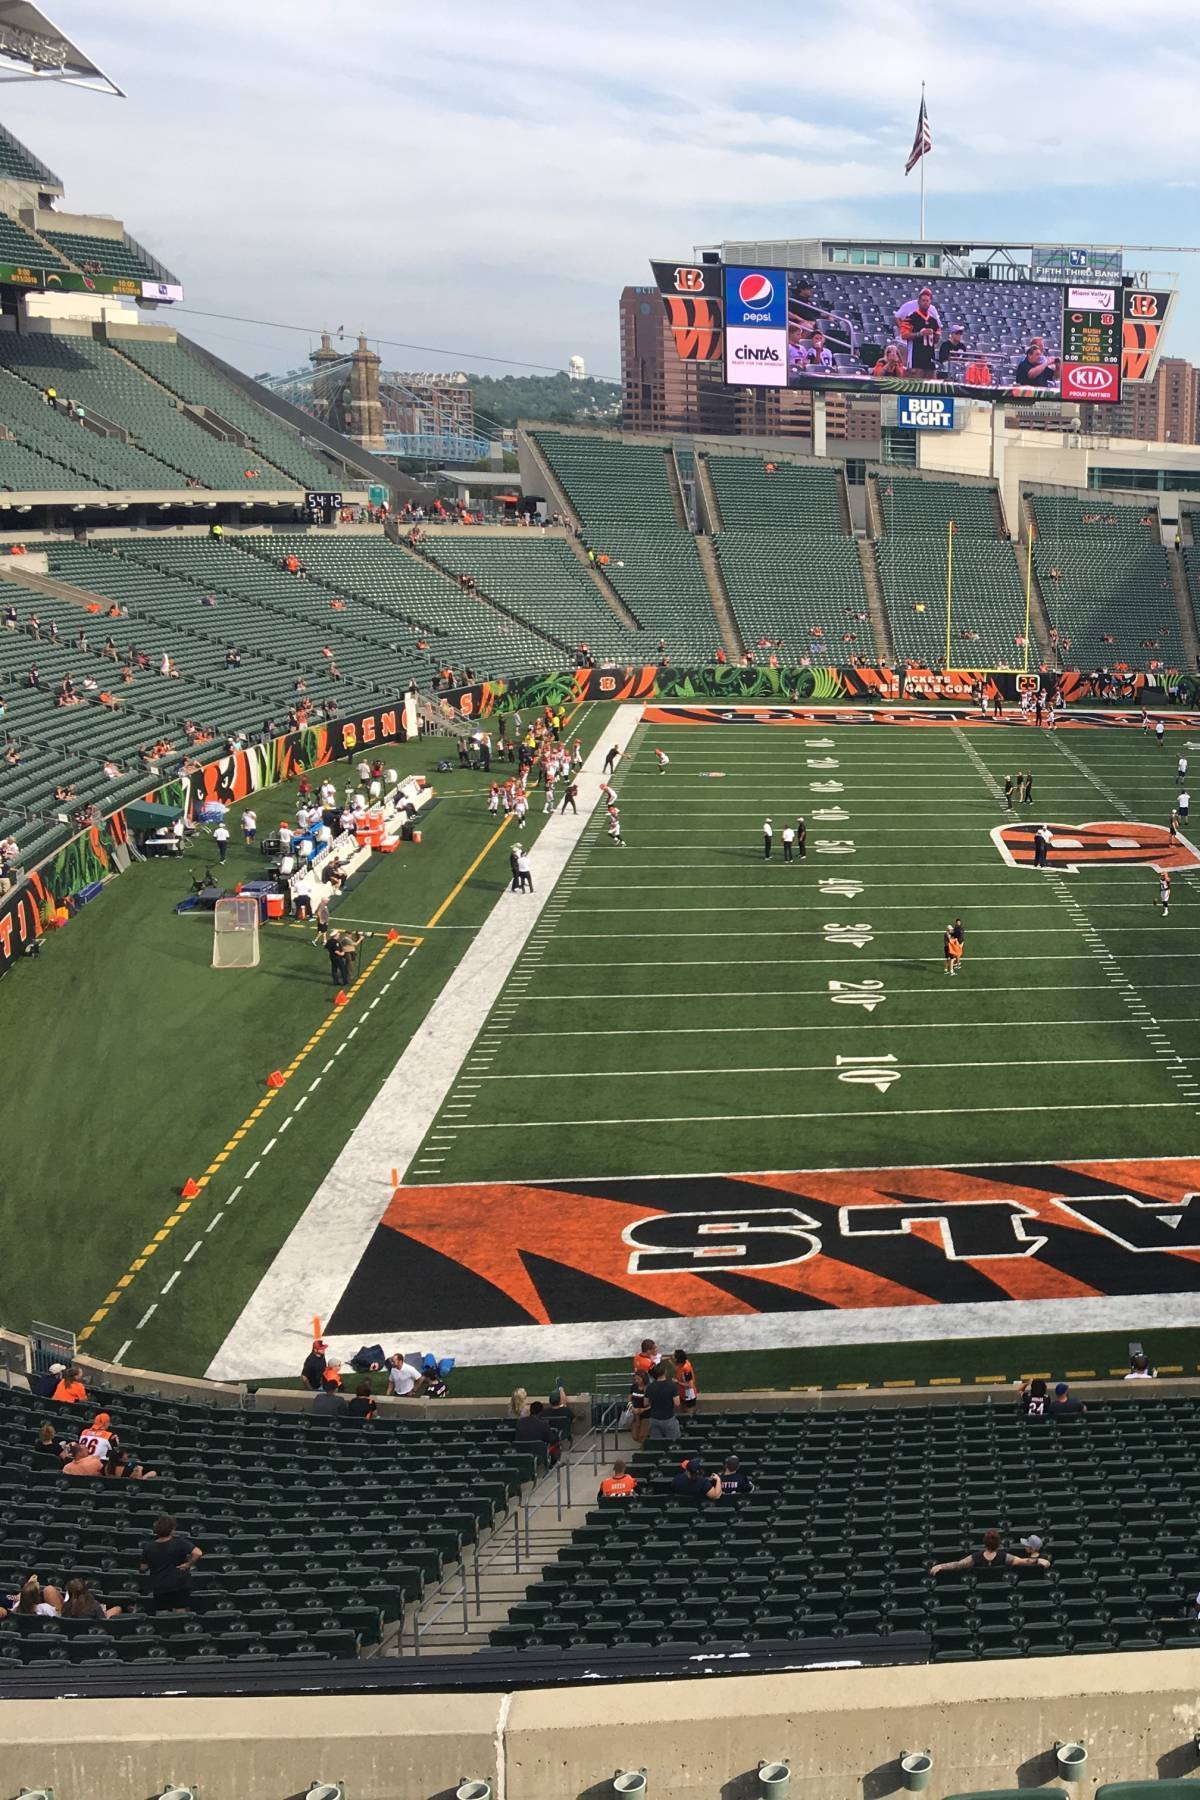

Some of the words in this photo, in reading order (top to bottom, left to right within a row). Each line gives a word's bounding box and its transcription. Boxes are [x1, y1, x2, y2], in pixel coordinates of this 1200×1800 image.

[1036, 266, 1061, 275] FIFTH
[1064, 268, 1092, 277] THIRD
[1095, 269, 1119, 278] BANK
[743, 312, 771, 322] pepsi
[1076, 371, 1105, 385] KIA
[908, 399, 945, 412] BUD
[901, 412, 951, 426] LIGHT
[309, 494, 341, 507] 54:12
[1020, 677, 1037, 689] 25
[823, 923, 874, 943] 30
[829, 979, 886, 1004] 20
[836, 1054, 901, 1083] 10
